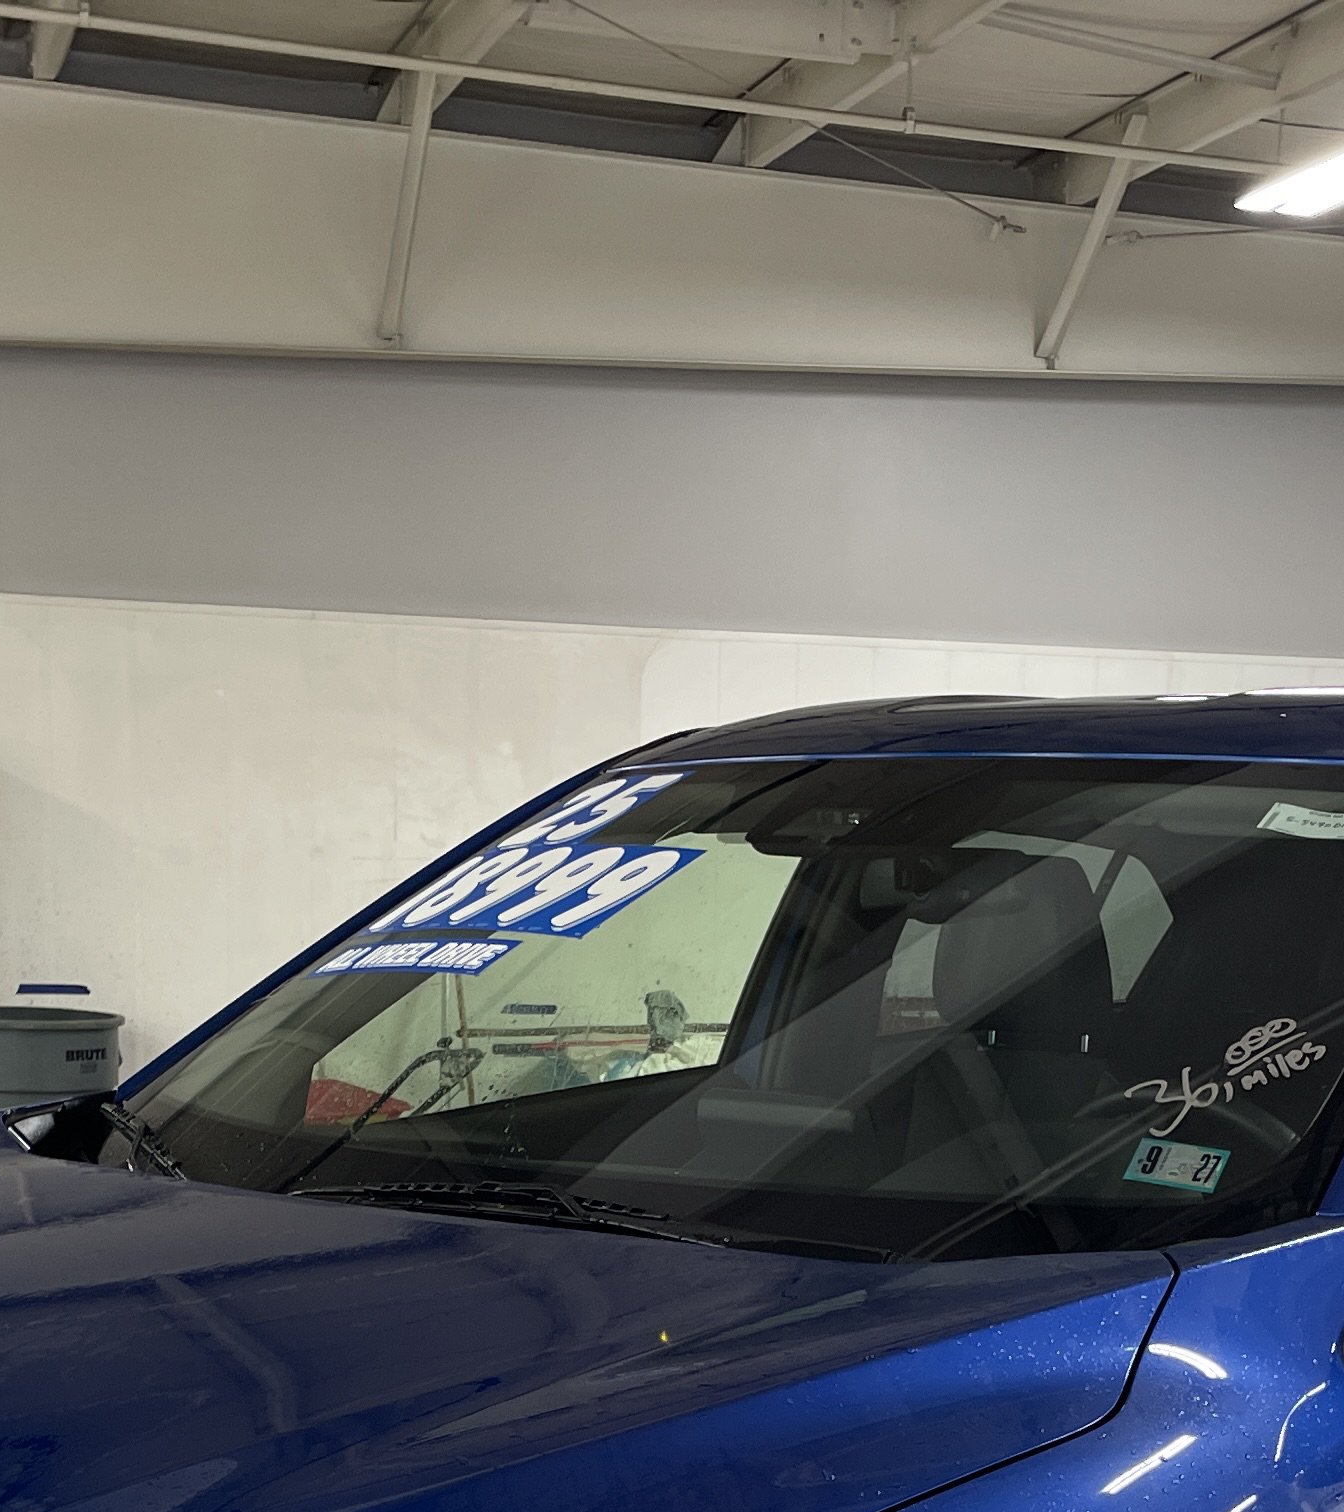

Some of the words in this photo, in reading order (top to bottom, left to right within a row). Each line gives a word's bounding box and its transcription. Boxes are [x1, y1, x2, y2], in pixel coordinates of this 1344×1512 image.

[497, 773, 684, 850] 25
[369, 846, 681, 931] 18999
[315, 946, 372, 974] ALL
[352, 942, 438, 969] WHEEL
[416, 942, 508, 970] DRIVE
[65, 1047, 107, 1062] BRUTE
[1240, 1041, 1327, 1091] miles
[1140, 1145, 1163, 1175] 9
[1191, 1153, 1222, 1185] 27
